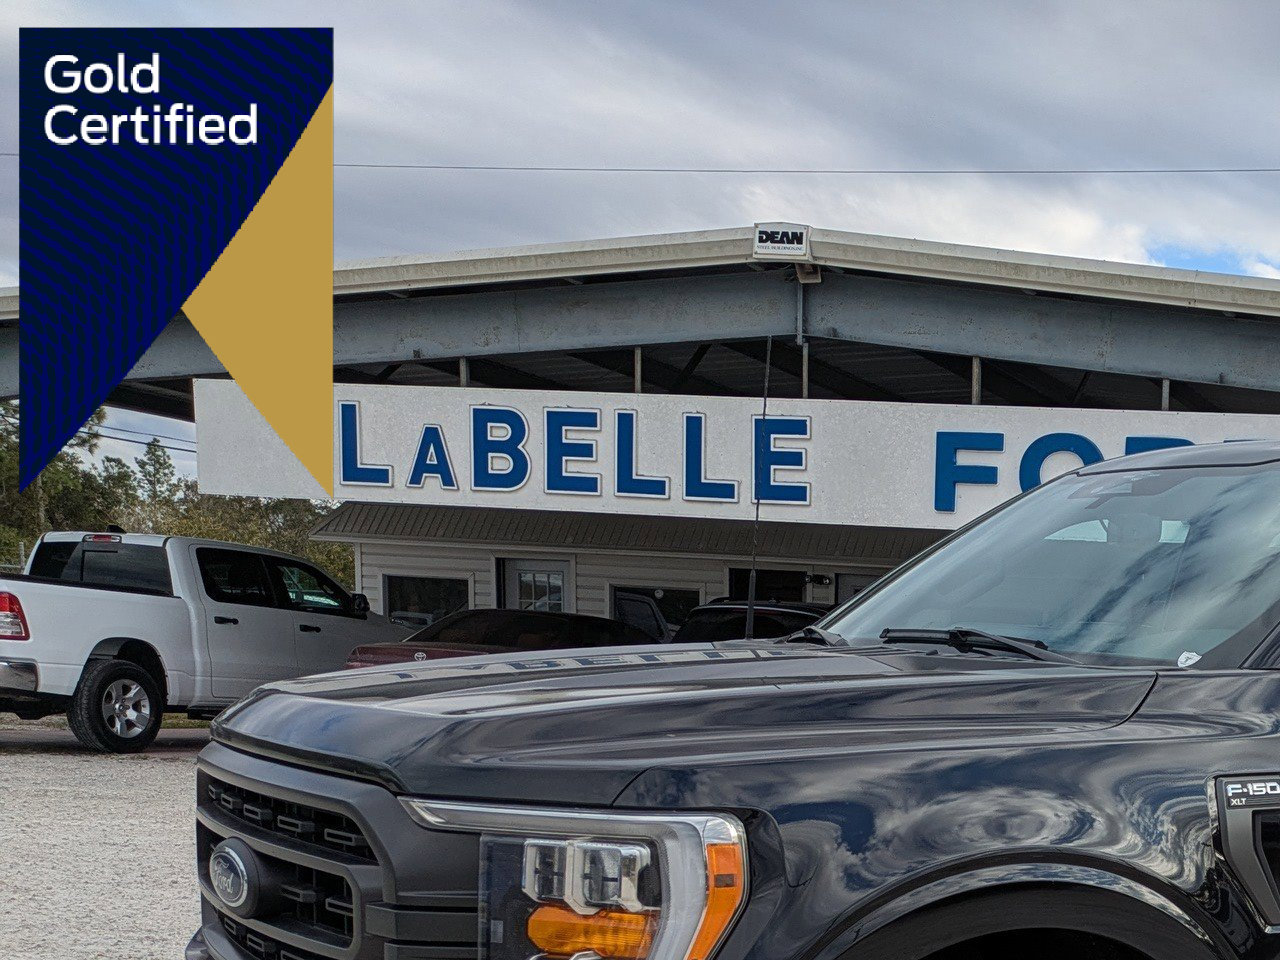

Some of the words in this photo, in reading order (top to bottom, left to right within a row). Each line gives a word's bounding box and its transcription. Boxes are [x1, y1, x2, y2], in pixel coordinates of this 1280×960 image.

[758, 230, 804, 245] DEAN
[338, 400, 811, 505] LABELLE
[933, 430, 1266, 514] FO
[1226, 781, 1280, 797] F-150
[1230, 798, 1247, 806] XLT
